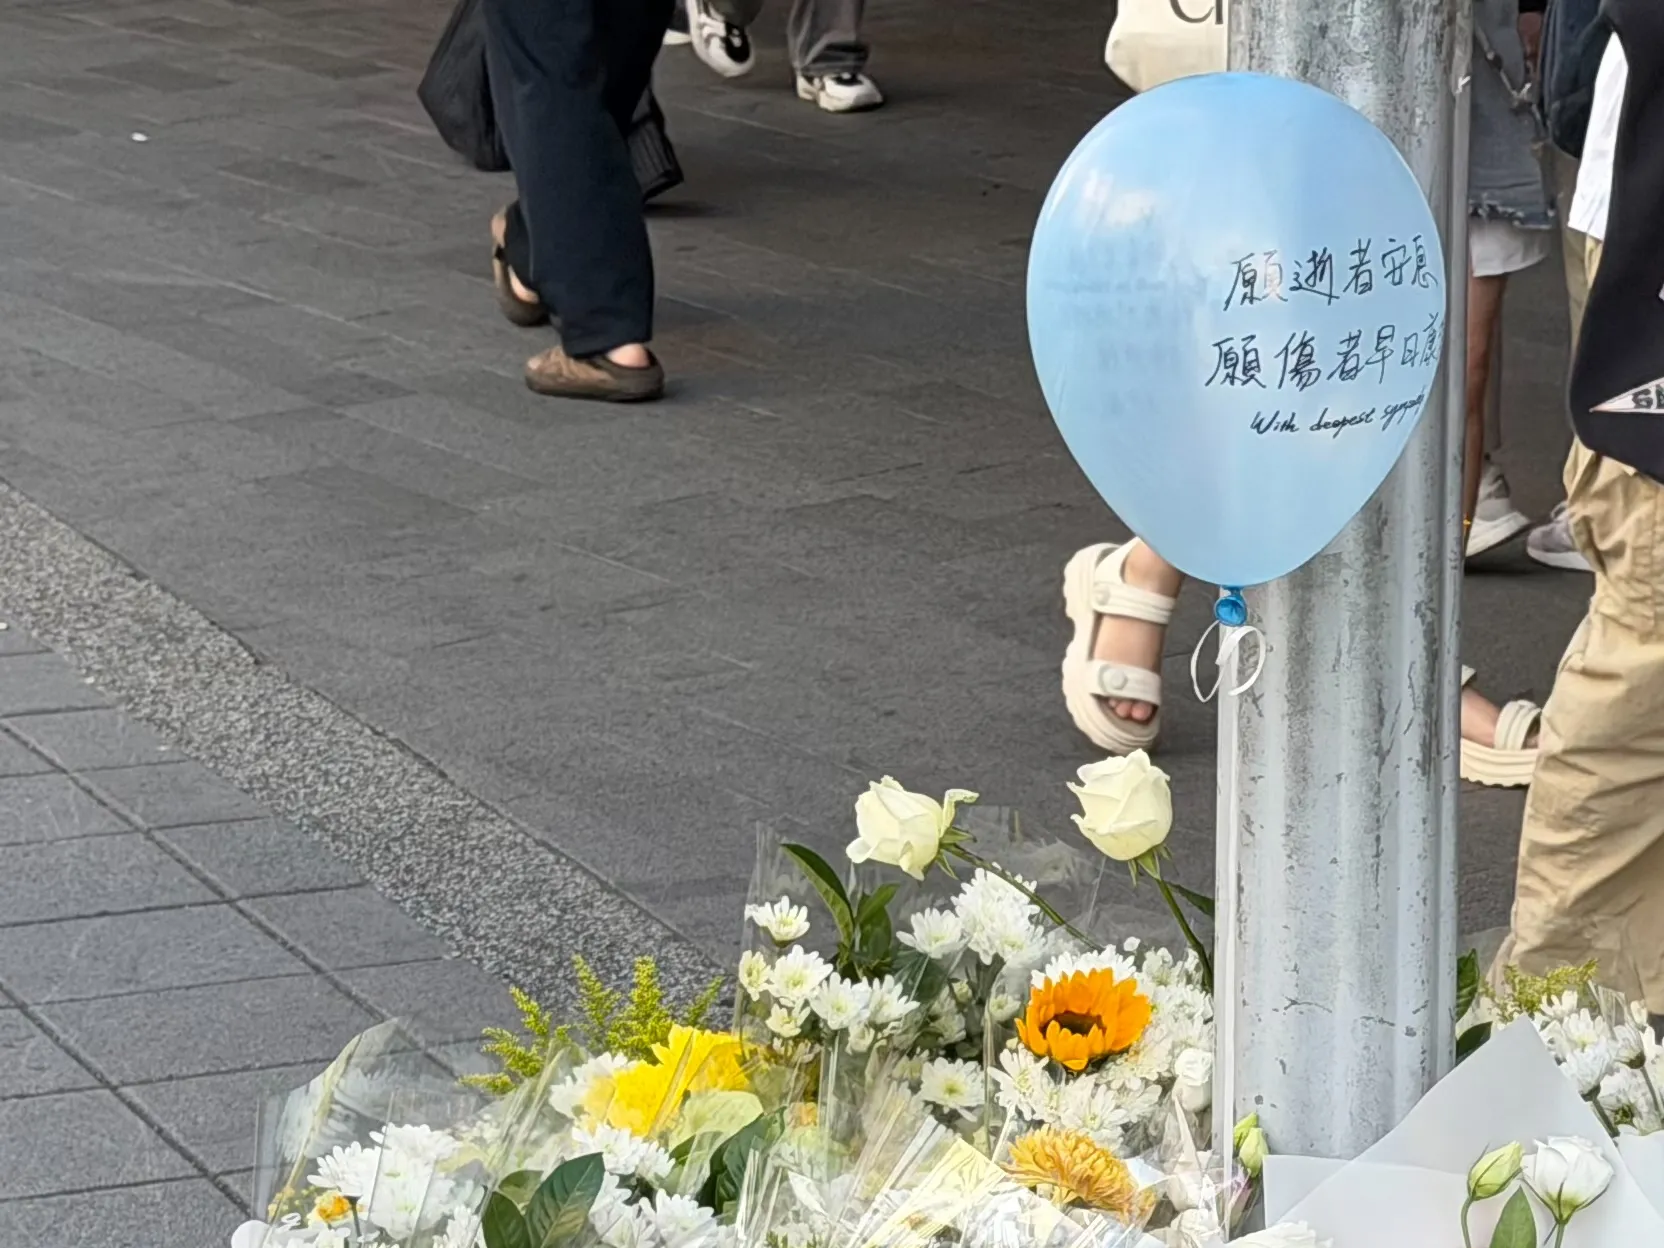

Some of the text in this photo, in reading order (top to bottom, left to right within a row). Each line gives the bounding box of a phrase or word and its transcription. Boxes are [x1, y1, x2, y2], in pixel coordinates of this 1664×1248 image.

[1223, 234, 1439, 311] 願逝者安息
[1205, 312, 1445, 391] 願傷者早日康
[1250, 410, 1299, 436] With
[1309, 406, 1376, 438] deepest
